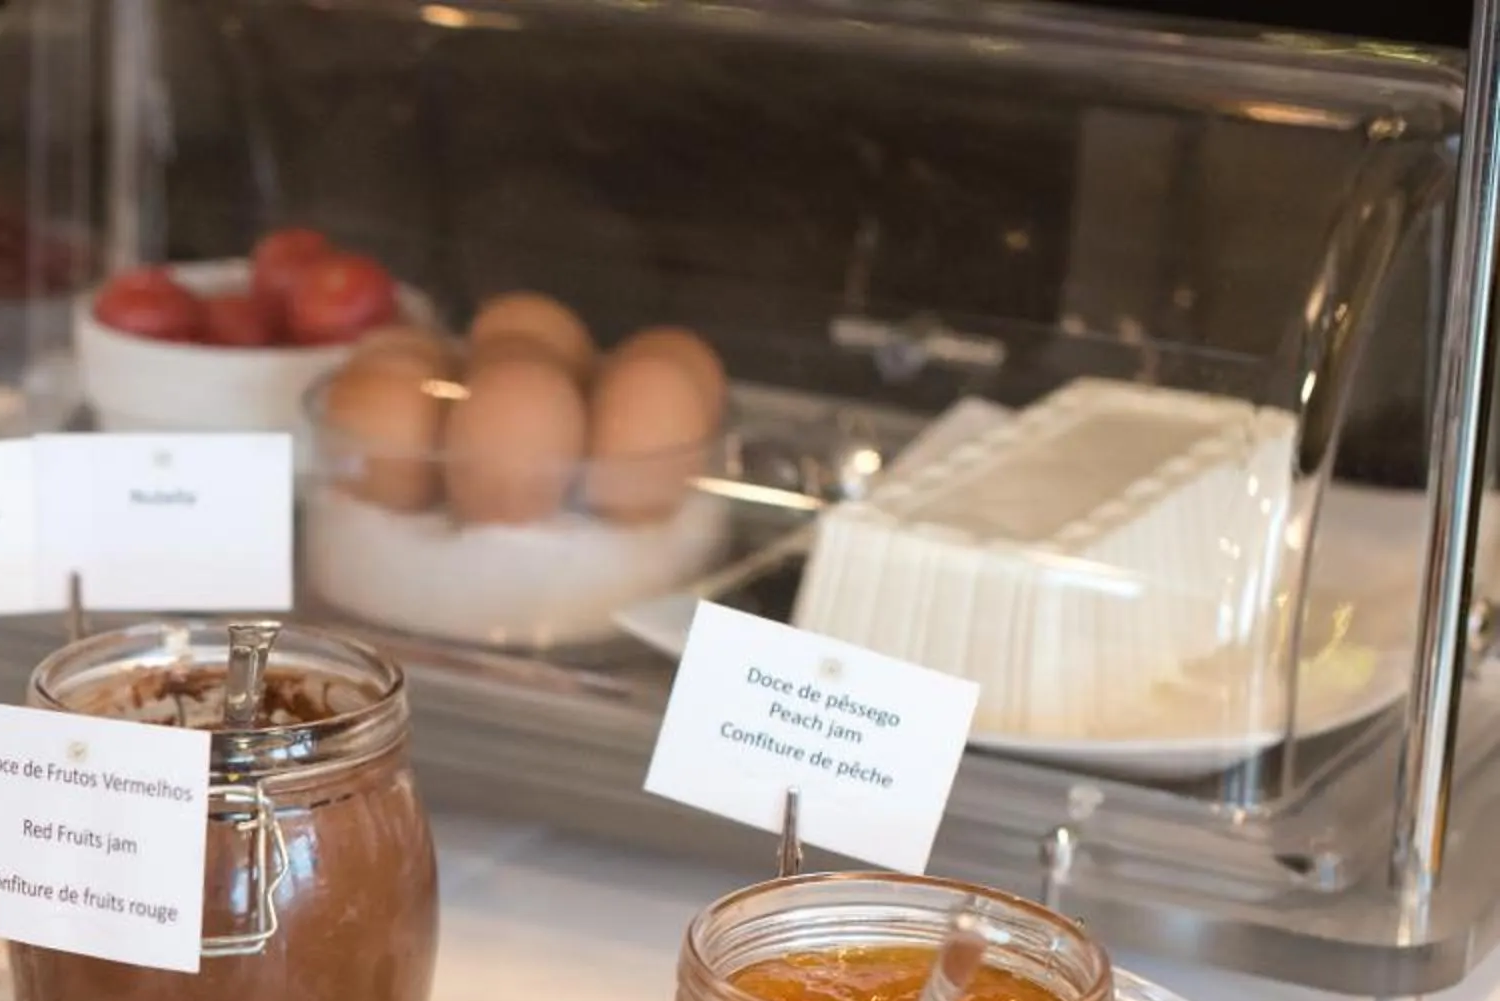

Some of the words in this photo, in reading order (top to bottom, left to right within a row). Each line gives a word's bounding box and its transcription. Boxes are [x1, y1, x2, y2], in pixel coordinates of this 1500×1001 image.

[747, 666, 794, 694] Doce
[797, 684, 821, 703] de
[769, 701, 823, 732] Peach
[825, 719, 863, 744] jam
[719, 721, 804, 760] Confiture
[809, 750, 833, 770] de
[835, 761, 894, 789] pêche
[23, 760, 44, 780] de
[47, 763, 97, 788] Frutos
[102, 773, 193, 802] Vermelhos
[23, 819, 53, 841] Red
[57, 825, 102, 849] Fruits
[106, 834, 138, 856] jam
[58, 885, 79, 904] de
[83, 887, 125, 914] fruits
[128, 903, 179, 924] rouge
